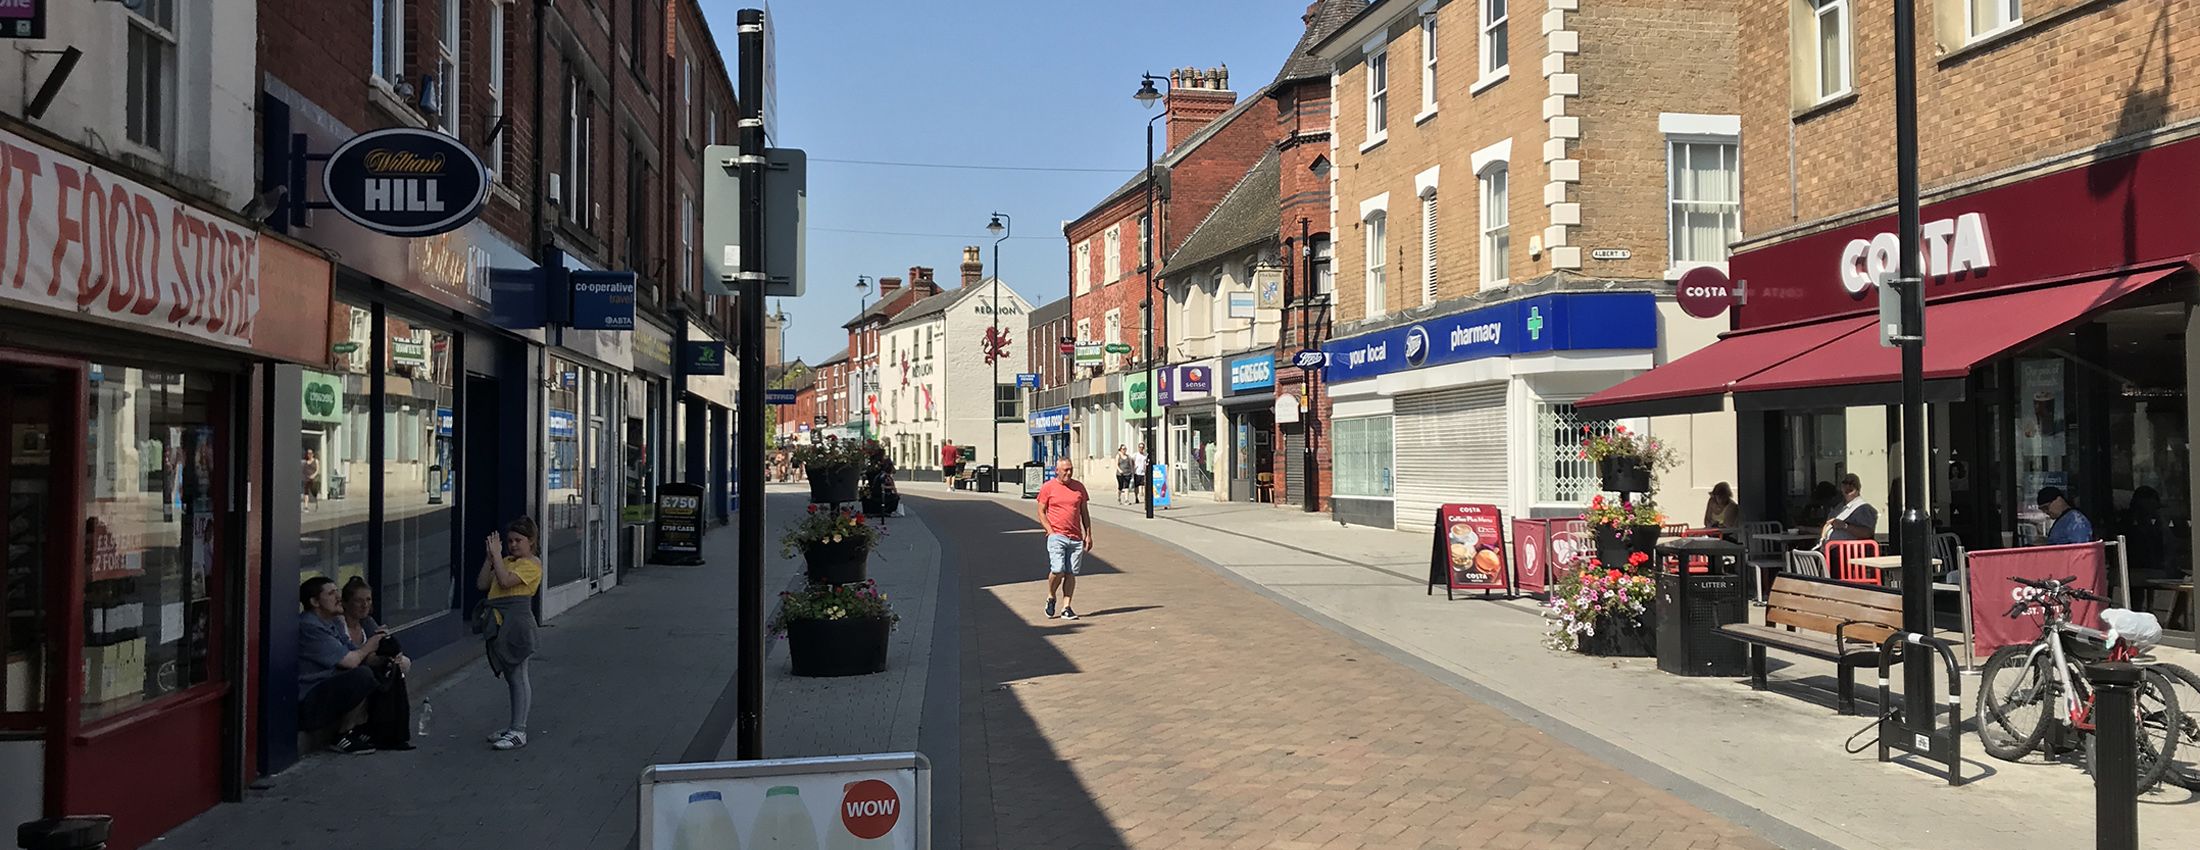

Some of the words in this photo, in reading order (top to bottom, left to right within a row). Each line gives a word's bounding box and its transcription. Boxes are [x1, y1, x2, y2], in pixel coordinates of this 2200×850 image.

[364, 149, 445, 174] William
[365, 178, 445, 211] HILL
[48, 162, 161, 316] FOOD
[168, 206, 257, 338] STORE
[1841, 212, 1990, 293] COTA
[1685, 286, 1728, 298] COSTA
[975, 306, 992, 315] RED
[994, 306, 1017, 316] ION
[1451, 322, 1501, 351] pharmacy
[1349, 347, 1366, 369] your
[1367, 340, 1387, 362] local
[1240, 362, 1270, 384] GREGGS
[662, 497, 697, 508] £750
[846, 799, 896, 817] WOW
